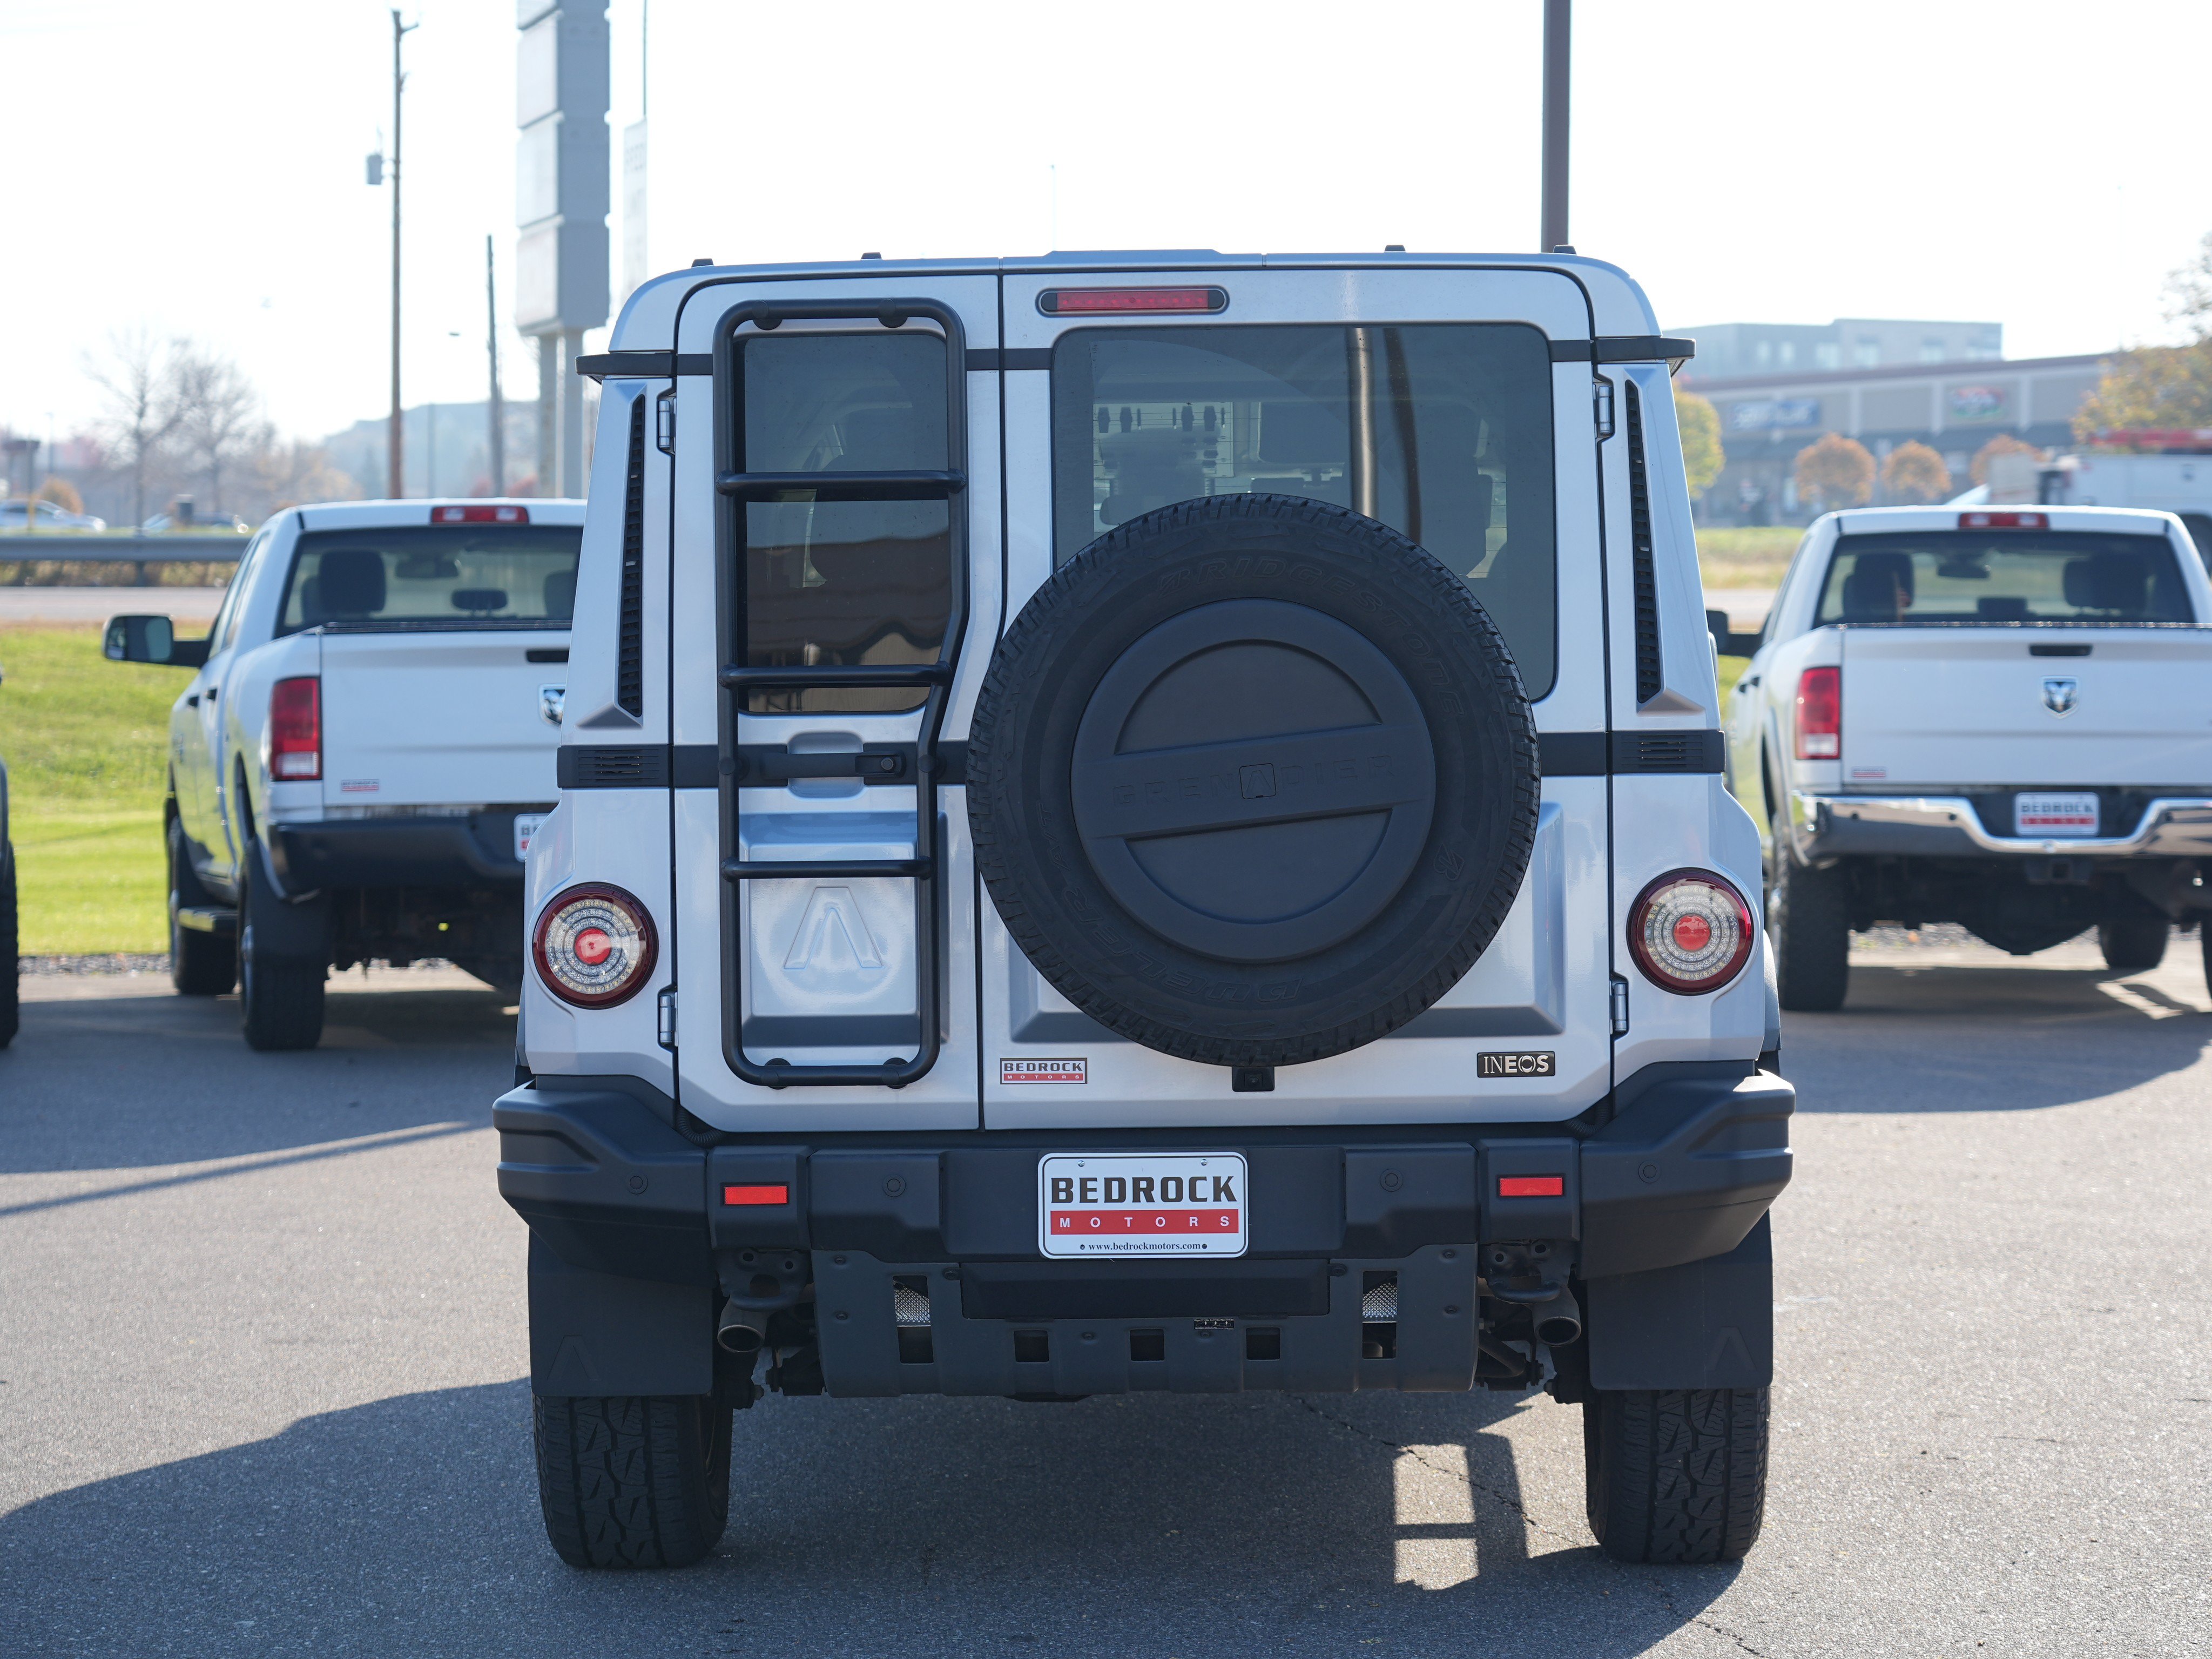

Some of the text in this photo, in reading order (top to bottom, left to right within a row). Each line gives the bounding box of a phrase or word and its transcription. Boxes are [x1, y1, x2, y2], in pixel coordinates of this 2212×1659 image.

[1156, 555, 1465, 716] BRIDGESTONE
[1111, 754, 1396, 808] GRENADIER
[1063, 886, 1304, 1003] DUELER
[1003, 1062, 1083, 1072] BEDROCK
[1483, 1055, 1549, 1074] INEOS
[1050, 1176, 1238, 1204] BEDROCK
[1059, 1216, 1230, 1228] MOTORS
[1088, 1242, 1201, 1251] www.bedrockmotors.com
